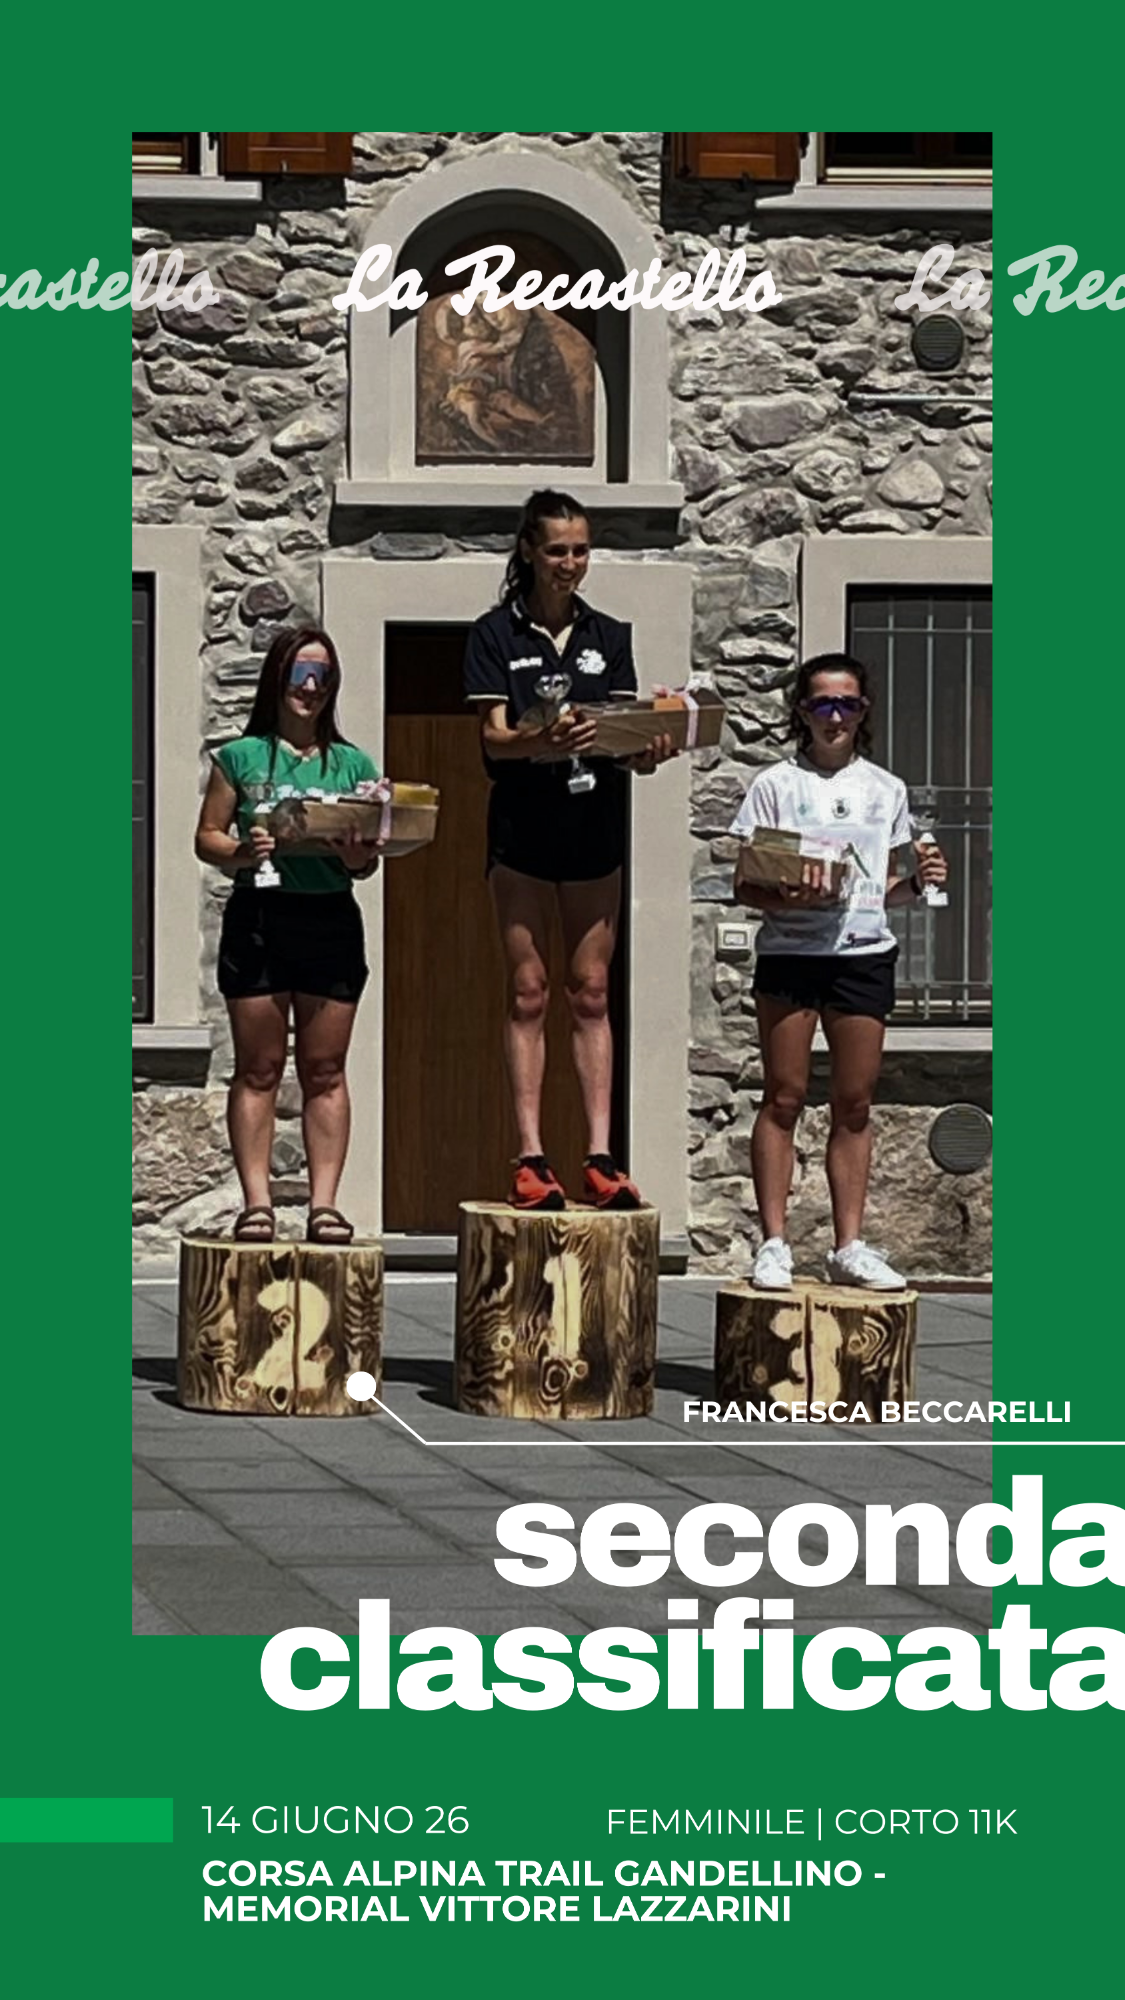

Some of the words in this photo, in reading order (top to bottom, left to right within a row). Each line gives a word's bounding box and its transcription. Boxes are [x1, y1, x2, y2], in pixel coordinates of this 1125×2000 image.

[253, 1278, 331, 1390] 2
[543, 1252, 583, 1361] 1
[768, 1307, 842, 1414] 3
